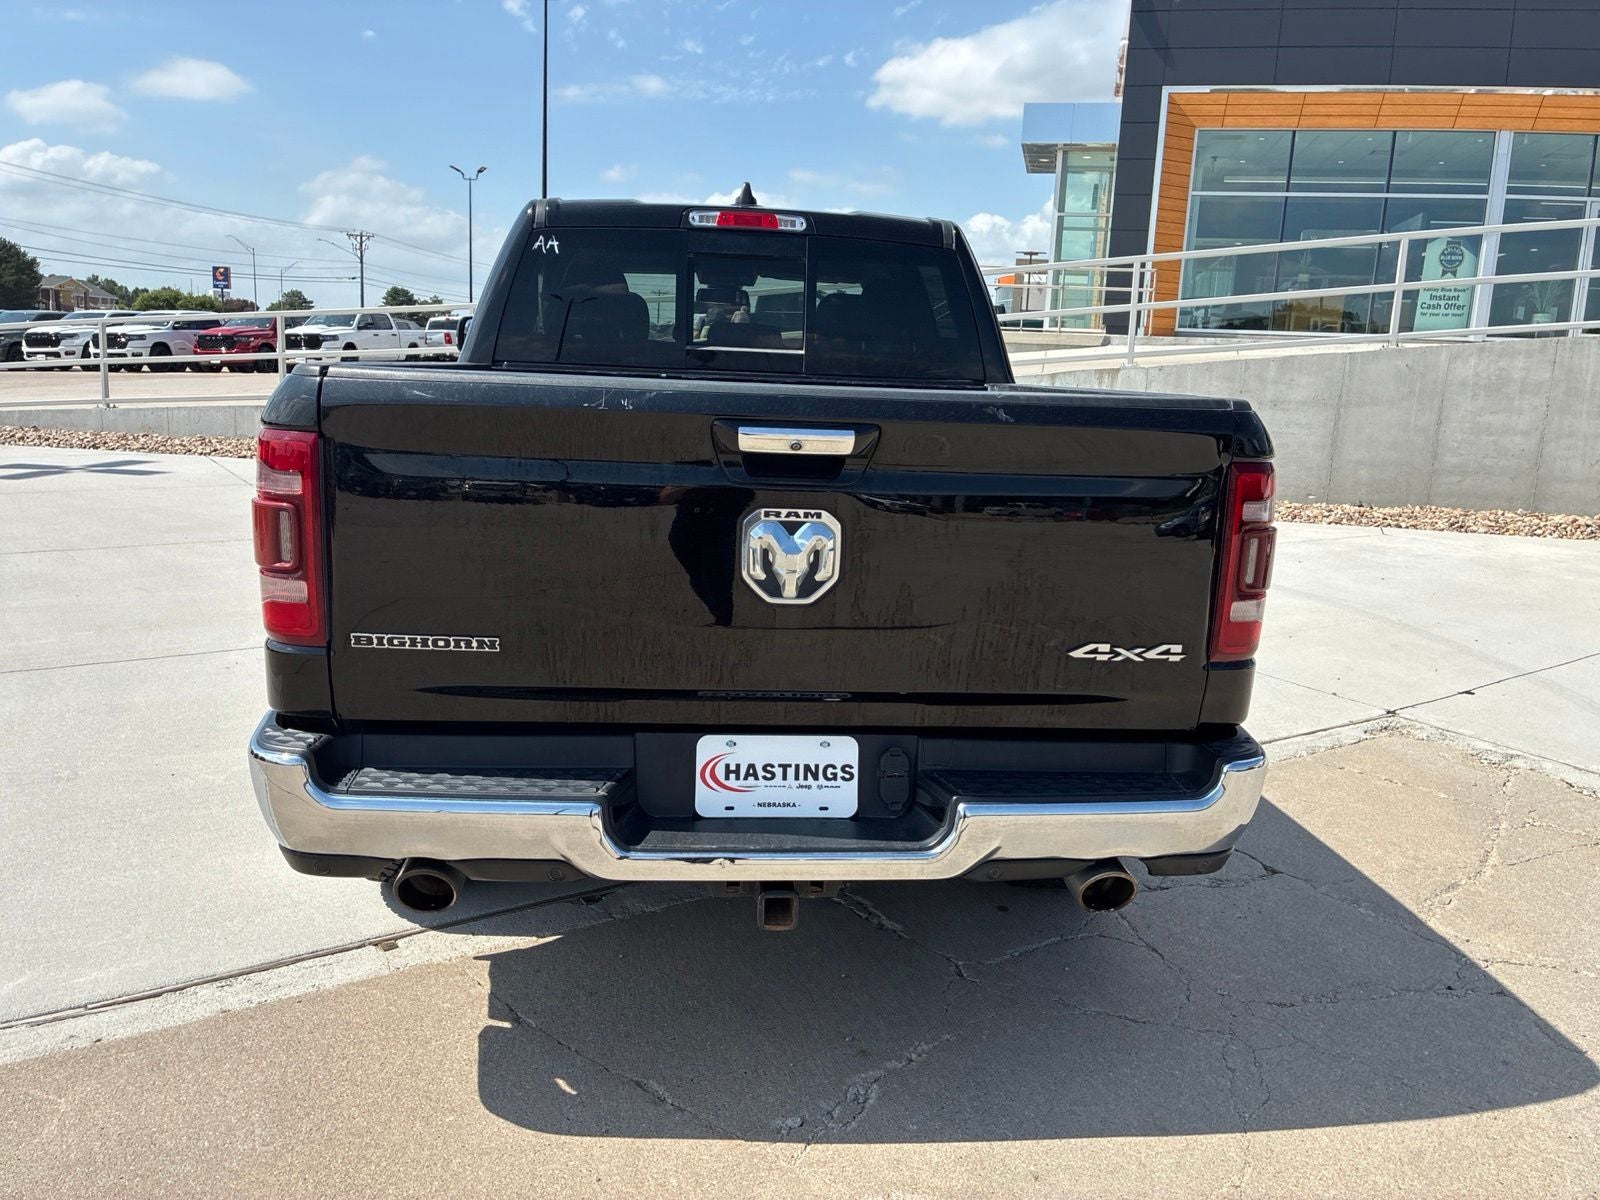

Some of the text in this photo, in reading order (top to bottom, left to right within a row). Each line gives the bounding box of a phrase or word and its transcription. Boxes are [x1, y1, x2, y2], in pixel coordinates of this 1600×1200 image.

[1429, 293, 1460, 301] Instant
[1420, 302, 1466, 311] Cash Offer
[763, 510, 822, 519] RAM
[350, 633, 500, 652] BIGHORN
[724, 762, 855, 782] HASTINGS
